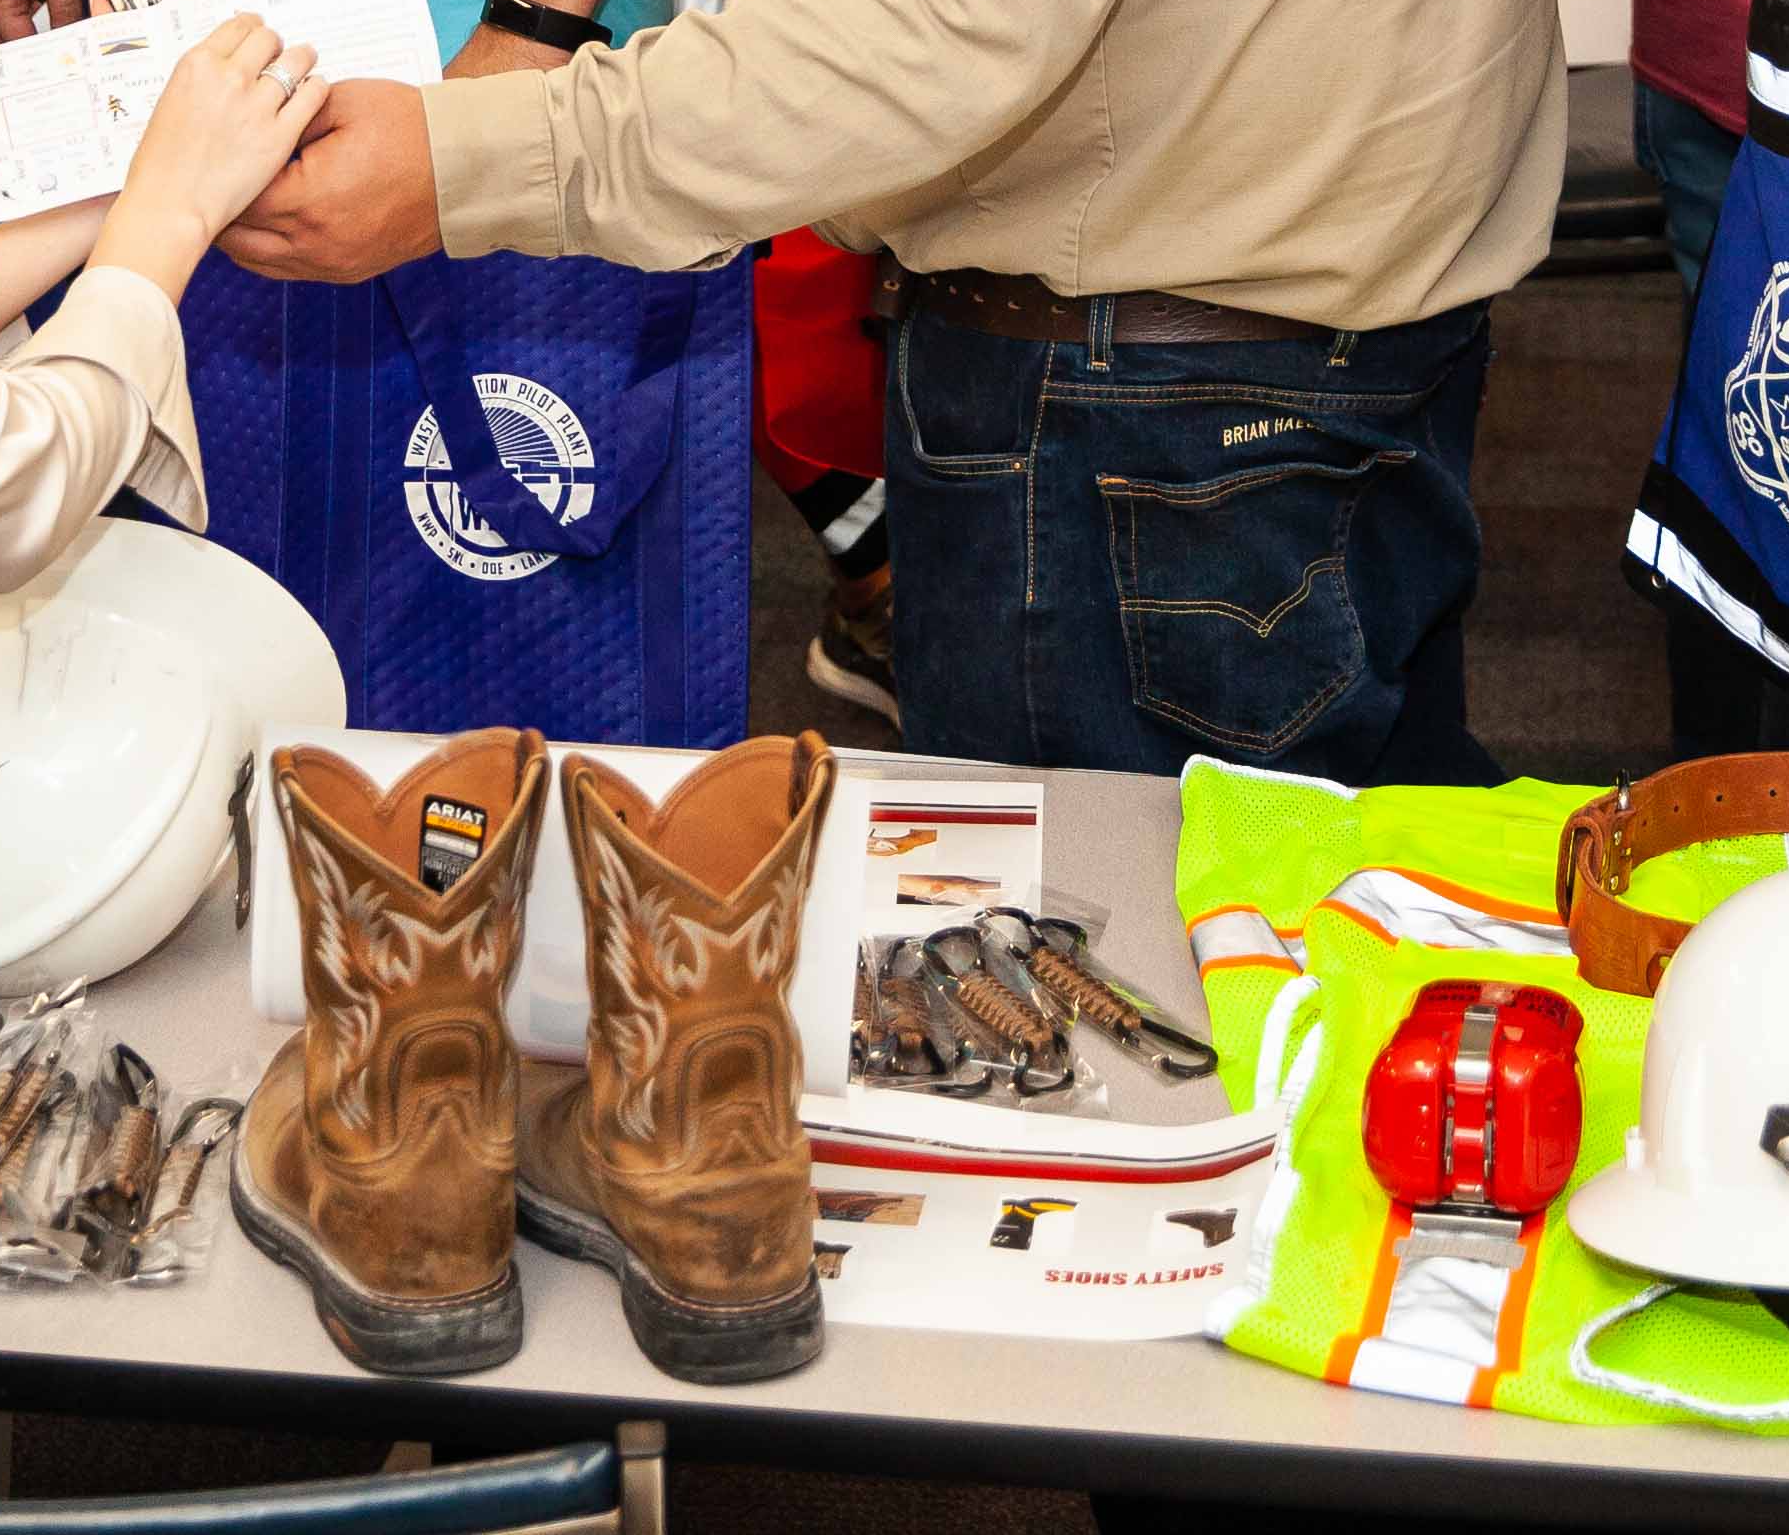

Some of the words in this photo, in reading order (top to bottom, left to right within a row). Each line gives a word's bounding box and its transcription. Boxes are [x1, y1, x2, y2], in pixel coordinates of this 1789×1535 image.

[476, 377, 508, 395] TION
[516, 383, 557, 413] PILOT
[556, 413, 588, 457] PLANT
[1223, 420, 1269, 447] BRIAN
[417, 512, 438, 538] NWP
[446, 547, 464, 567] SNL
[481, 562, 504, 575] DOE
[427, 802, 485, 825] ARIAT
[1044, 1269, 1128, 1285] SHOES
[1135, 1262, 1225, 1285] SAFETY
